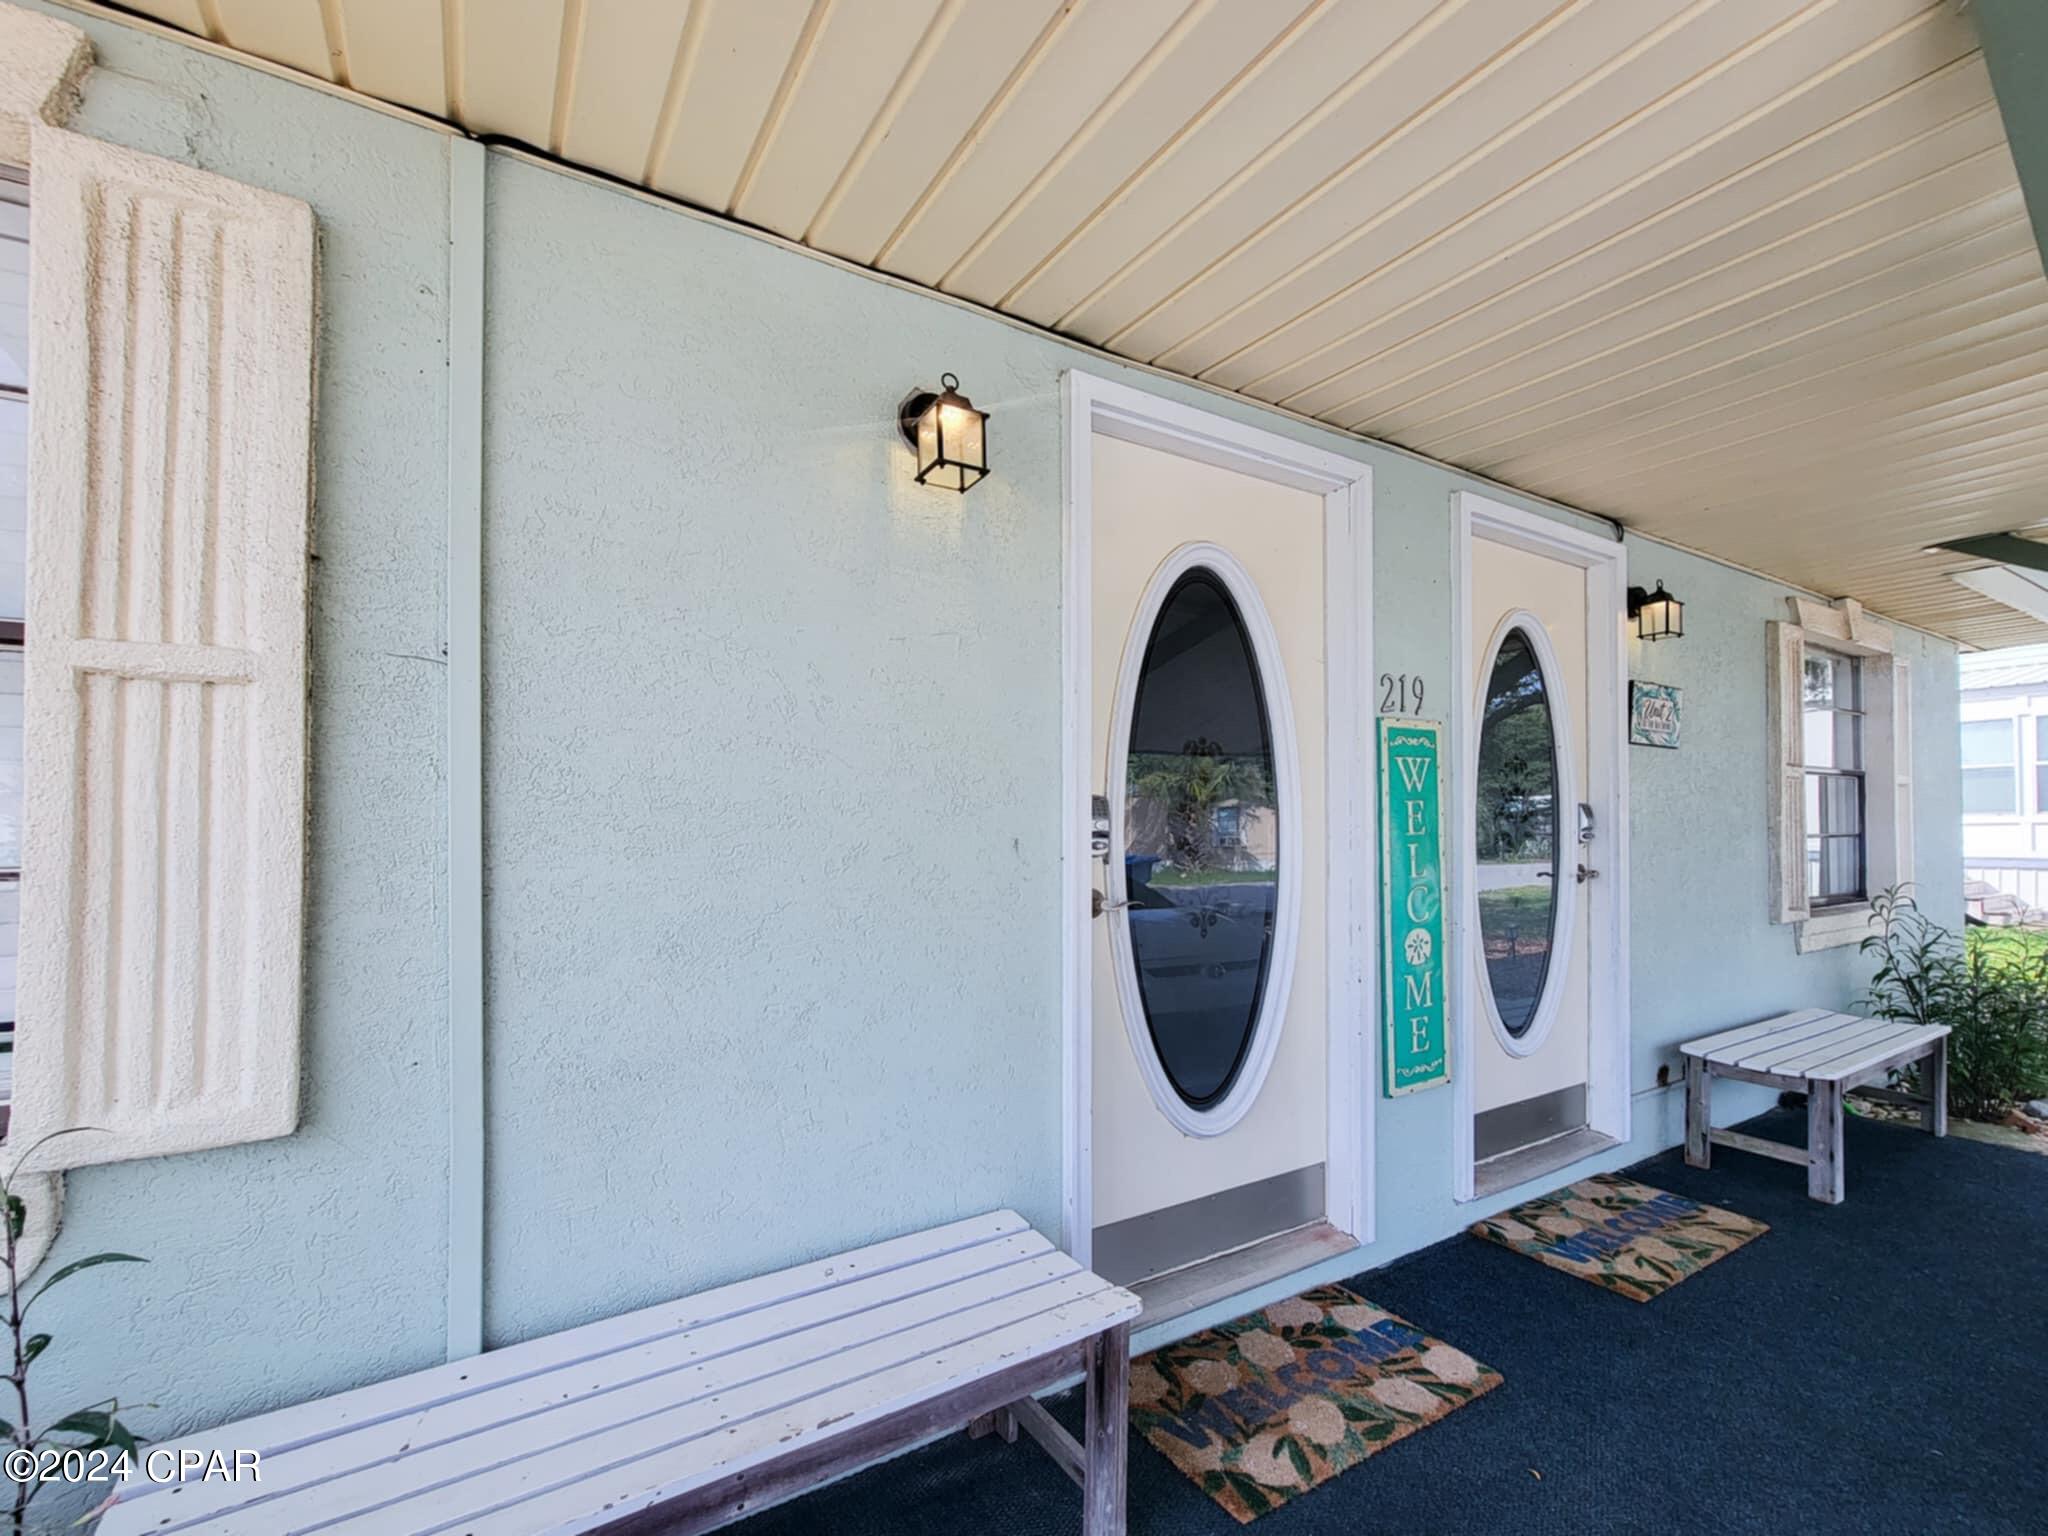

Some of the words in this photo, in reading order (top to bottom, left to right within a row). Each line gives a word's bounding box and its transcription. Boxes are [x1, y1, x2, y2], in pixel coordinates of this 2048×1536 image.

[1380, 673, 1424, 715] 219
[1395, 756, 1433, 1053] WELCOME
[1549, 1193, 1701, 1264] WELCOME
[1156, 1319, 1425, 1449] WELCOME
